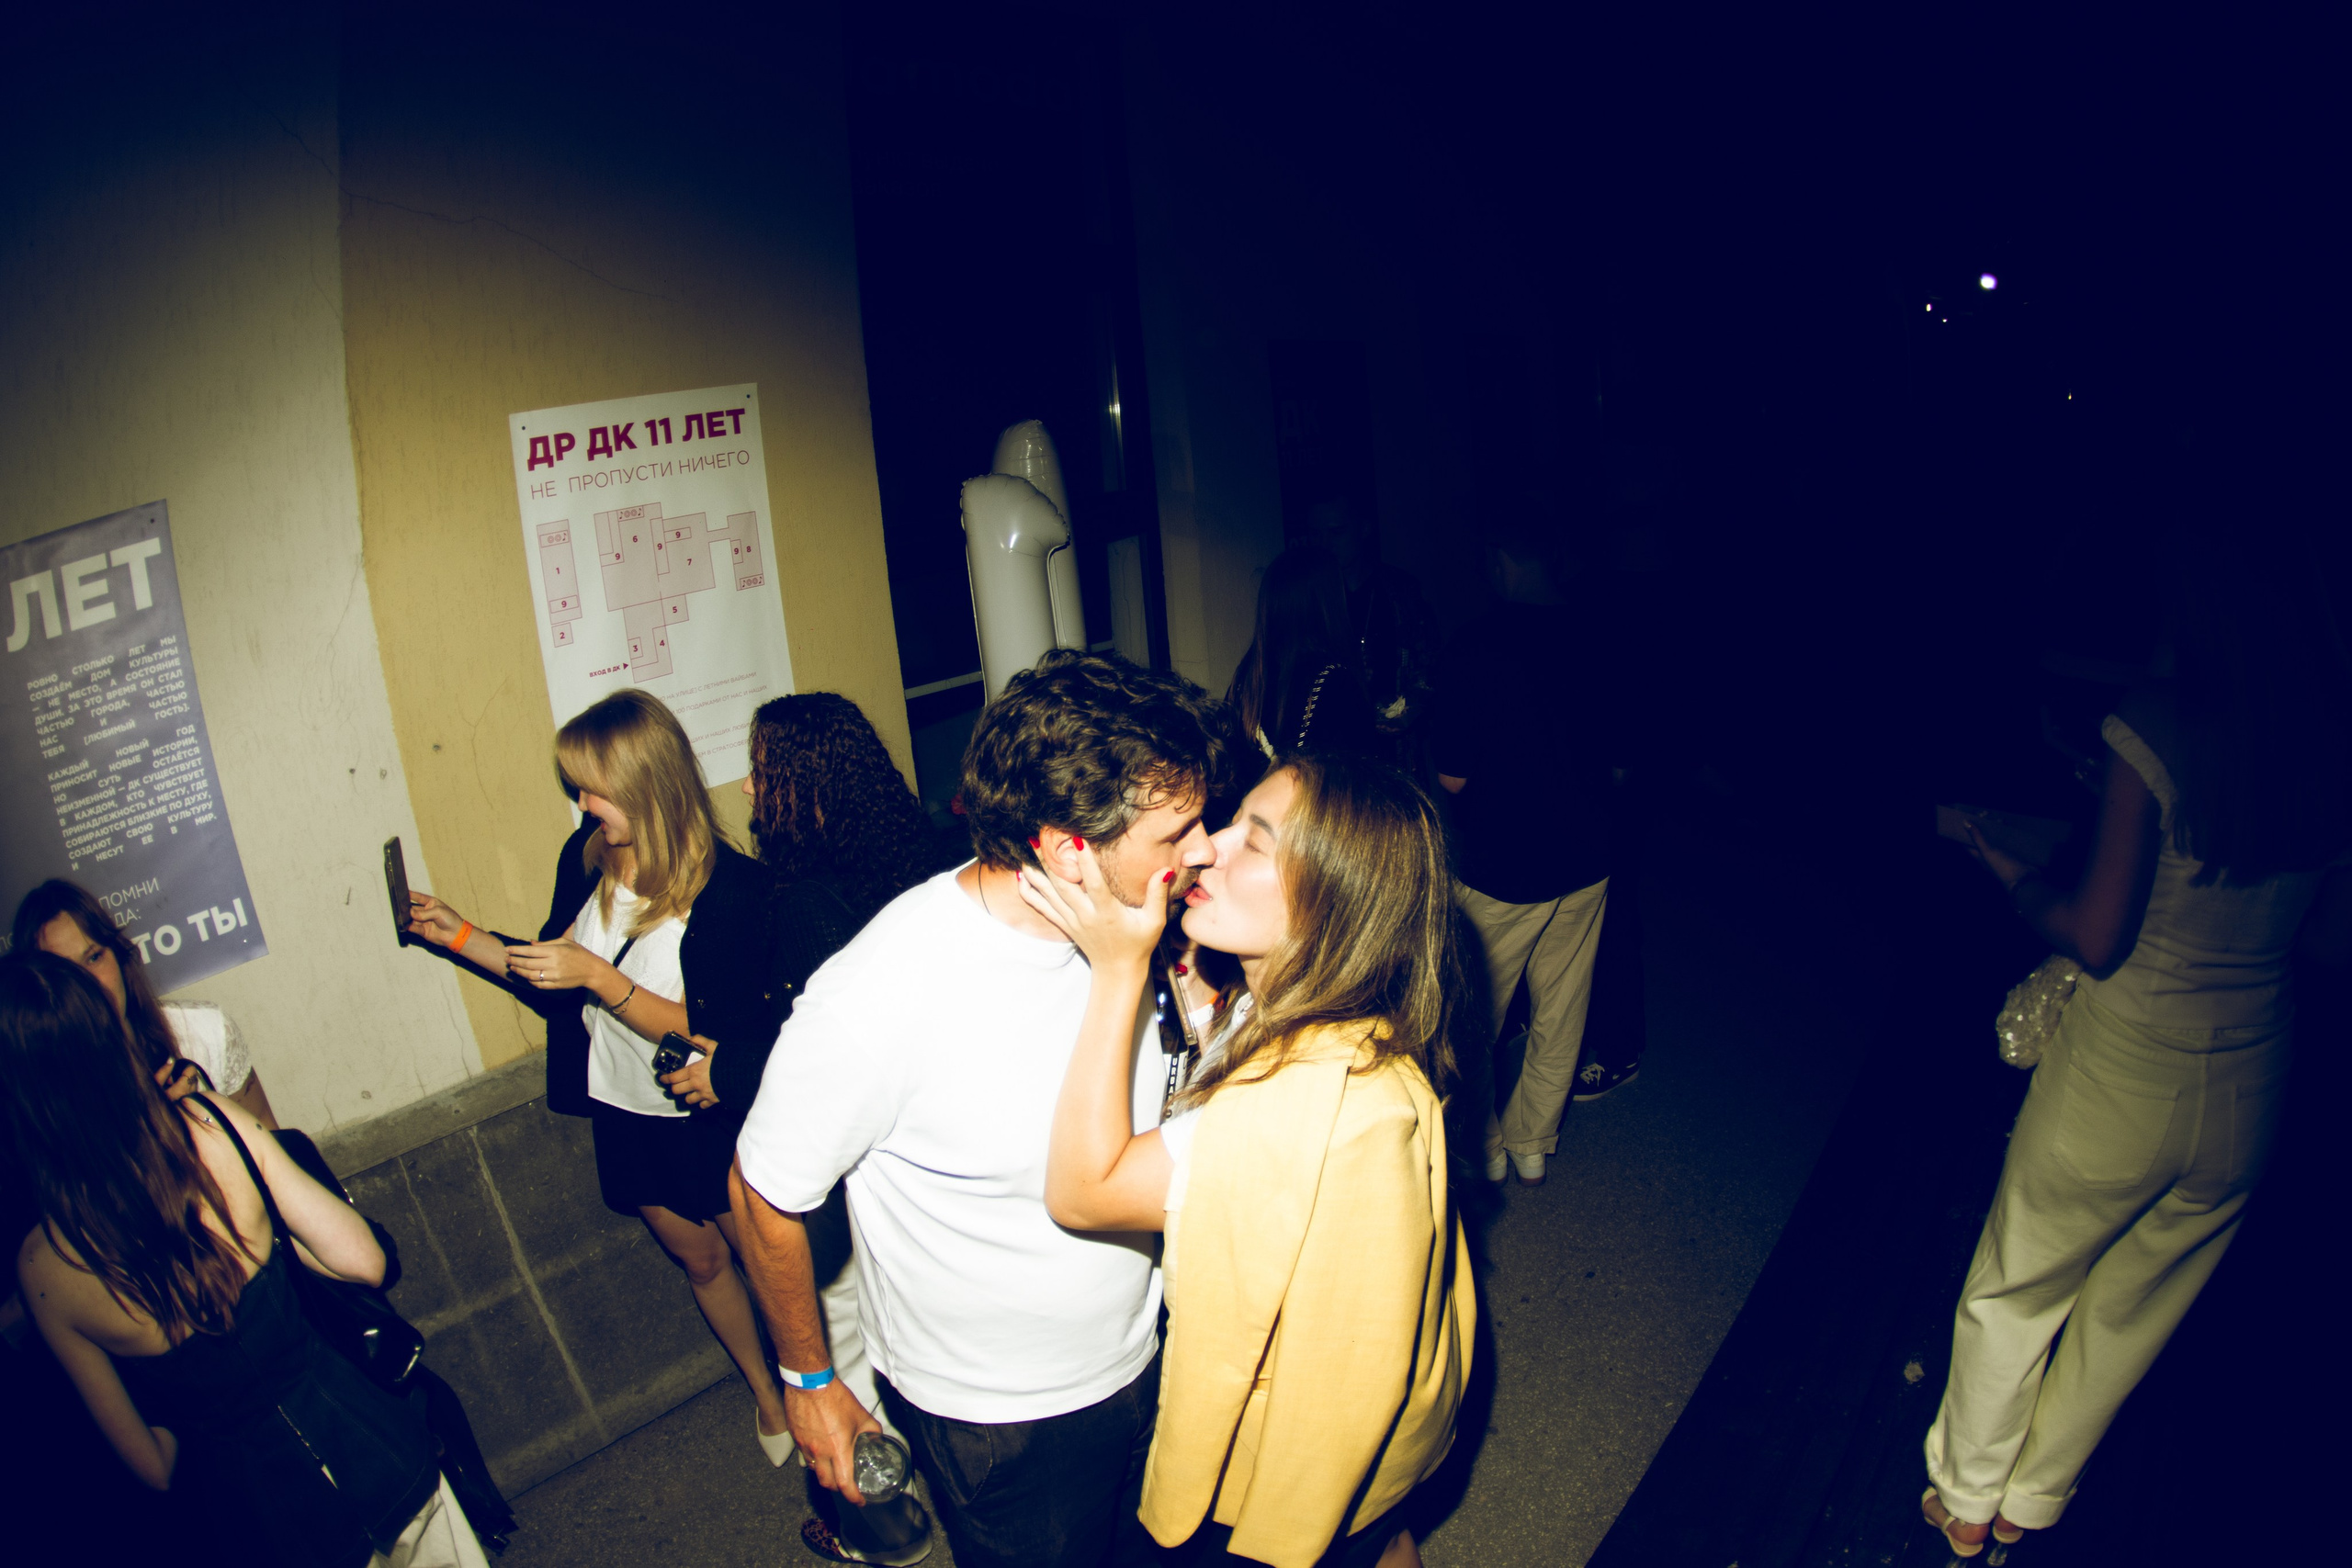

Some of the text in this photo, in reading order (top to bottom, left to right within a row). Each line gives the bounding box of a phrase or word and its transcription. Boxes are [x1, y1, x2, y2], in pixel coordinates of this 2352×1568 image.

[527, 408, 746, 471] ДР ДК 11 ЛЕТ
[531, 450, 750, 500] НЕ ПРОПУСТИ НИЧЕГО
[632, 535, 638, 543] 6
[6, 537, 161, 653] ЛЕТ
[28, 635, 176, 691] РОВНО СТОЛЬКО ЛЕТ МЫ
[29, 647, 179, 703] СОЗДАЁМ ДОМ КУЛЬТУРЫ
[48, 696, 61, 707] НЕ
[68, 684, 102, 702] МЕСТО,
[110, 680, 117, 688] А
[125, 658, 180, 682] СОСТОЯНИЕ
[589, 669, 606, 678] ВХОД
[612, 664, 621, 672] ДК
[676, 688, 697, 697] УЛИЦЕ]
[704, 680, 729, 690] ЛЕТНИМИ
[730, 671, 757, 683] ВАЙБАМИ
[35, 669, 183, 727] ДУШИ. ЗА ЭТО ВРЕМЯ ОН СТАЛ
[37, 680, 185, 737] ЧАСТЬЮ ГОРОДА, ЧАСТЬЮ
[40, 692, 187, 749] НАС И ЧАСТЬЮ
[686, 697, 721, 711] ПОДАРКАМИ
[749, 684, 768, 694] НАШИХ
[41, 705, 190, 760] ТЕБЯ [ЛЮБИМЫЙ ГОСТЬ].
[48, 724, 195, 783] КАЖДЫЙ НОВЫЙ ГОД
[691, 735, 704, 743] ШИХ
[732, 722, 751, 731] ЛЮБИ
[712, 739, 748, 753] СТРАТОСФЕР
[51, 737, 198, 793] ПРИНОСИТ НОВЫЕ ИСТОРИИ,
[53, 746, 200, 805] НО СУТЬ ОСТАЁТСЯ
[56, 786, 116, 816] НЕИЗМЕННОЙ
[128, 779, 141, 792] ДК
[142, 757, 202, 785] СУЩЕСТВУЕТ
[59, 768, 205, 827] В КАЖДОМ, КТО ЧУВСТВУЕТ
[62, 780, 209, 838] ПРИНАДЛЕЖНОСТЬ К МЕСТУ, ГДЕ
[65, 791, 211, 849] СОБИРАЮТСЯ БЛИЗКИЕ ПО ДУХУ,
[68, 801, 214, 860] СОЗДАЮТ СВОЮ КУЛЬТУРУ
[72, 815, 217, 872] И НЕСУТ ЕЕ В МИР.
[99, 877, 160, 909] ПОМНИ
[114, 908, 141, 929] ДА:
[130, 897, 248, 965] ТО ТЫ
